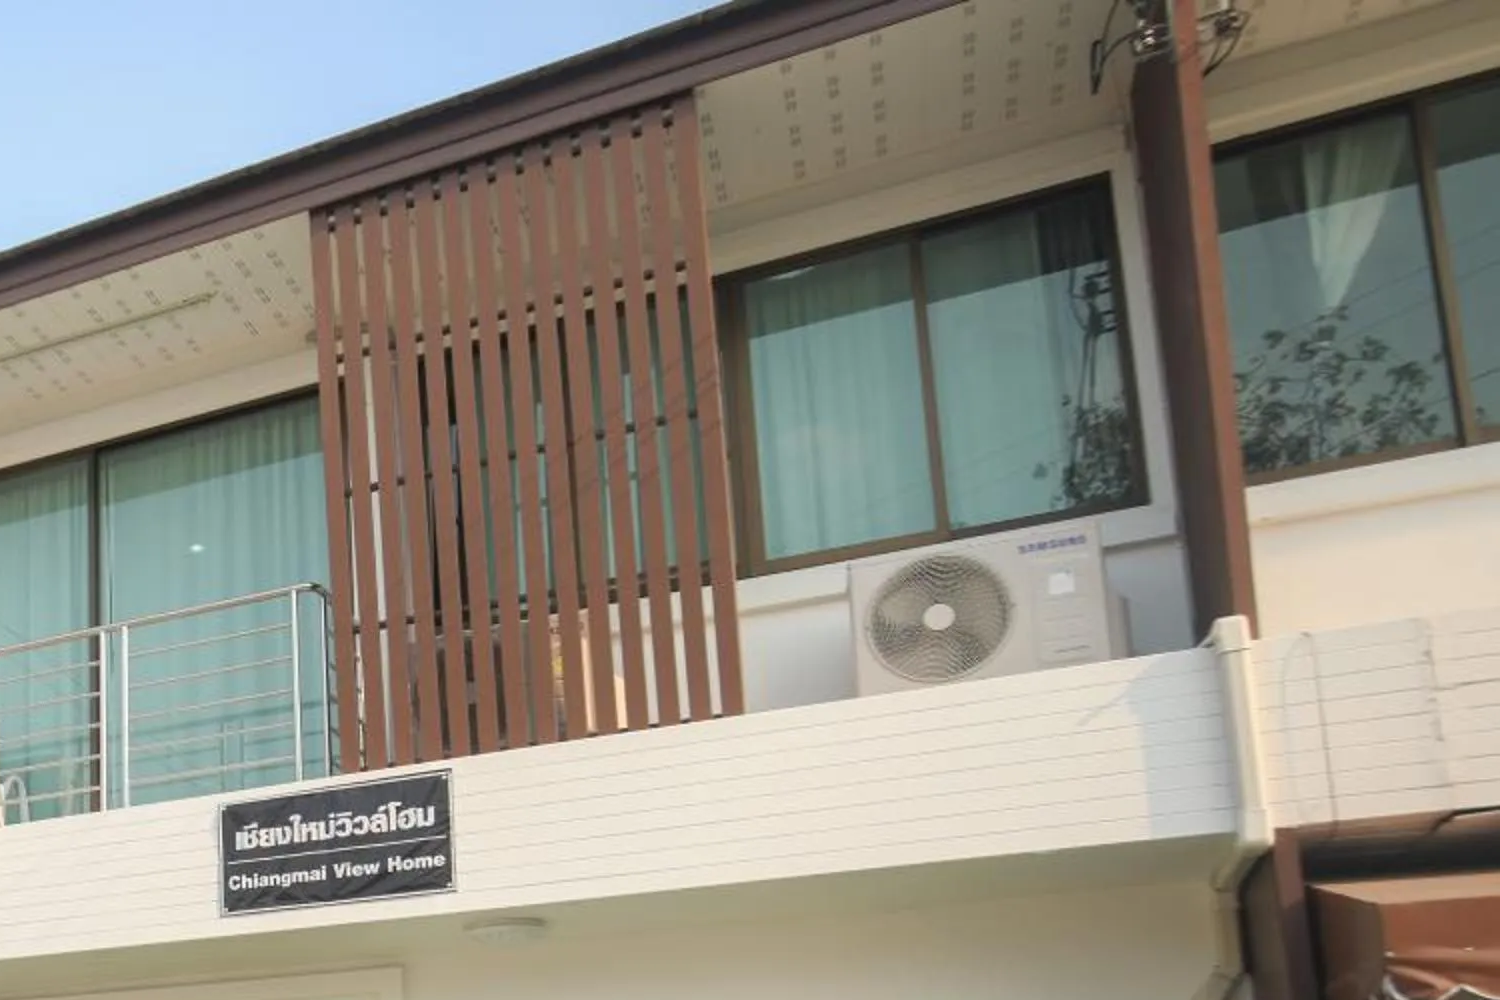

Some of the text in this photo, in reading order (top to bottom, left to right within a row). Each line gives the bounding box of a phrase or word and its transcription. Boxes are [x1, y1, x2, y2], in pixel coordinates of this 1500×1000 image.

[228, 854, 446, 890] Chiangmai View Home
